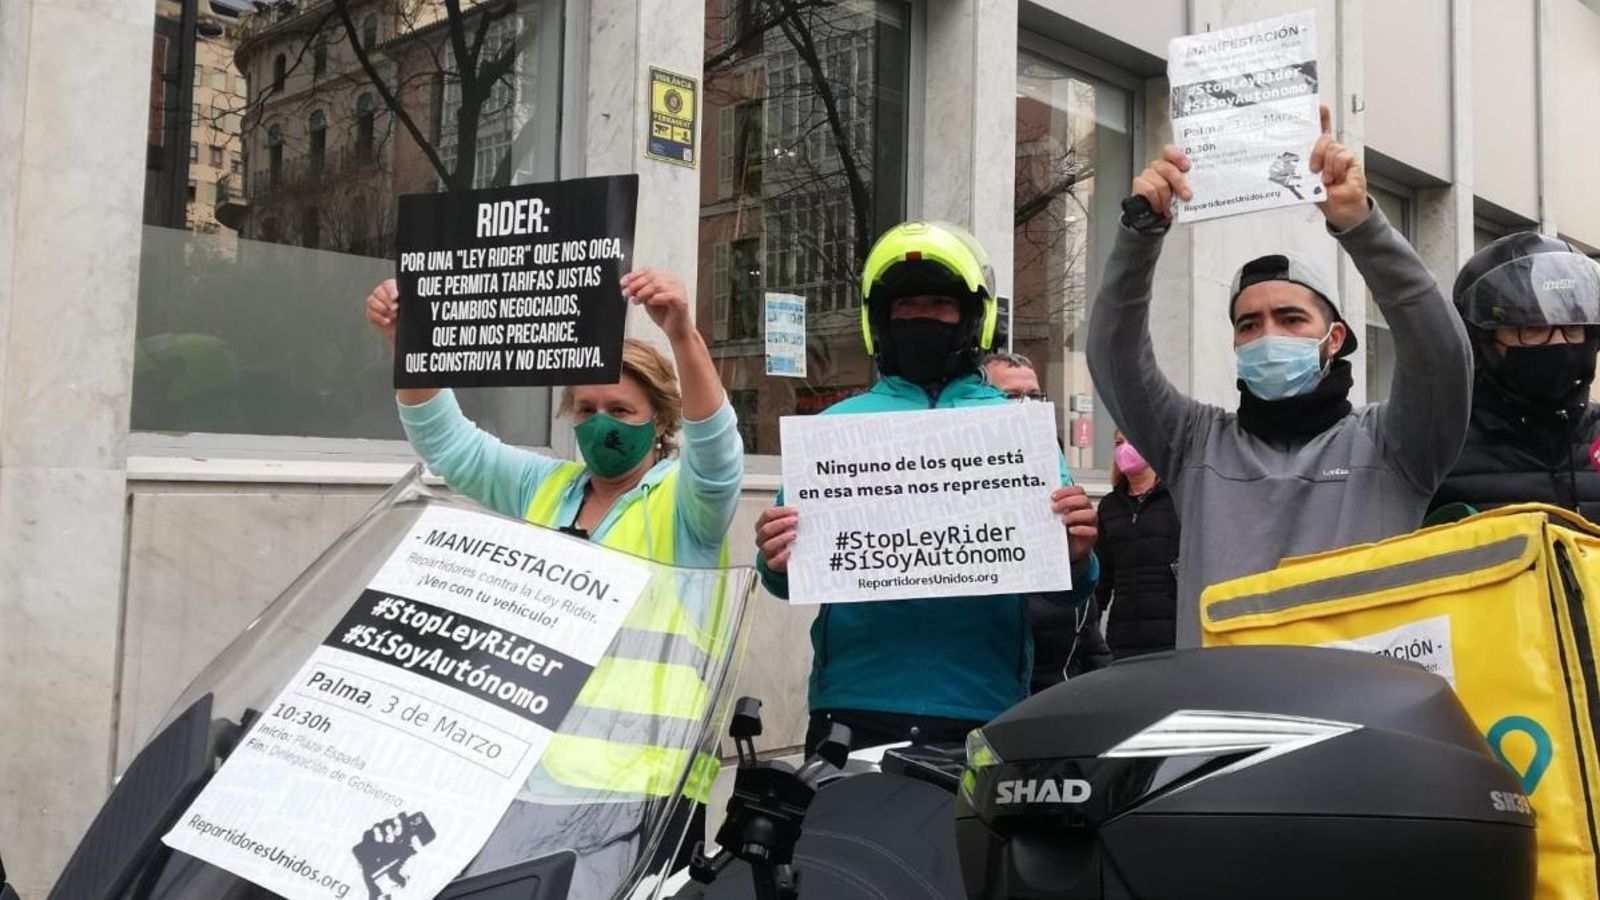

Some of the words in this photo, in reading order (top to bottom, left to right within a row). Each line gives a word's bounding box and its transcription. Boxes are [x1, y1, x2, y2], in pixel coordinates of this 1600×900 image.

[1188, 68, 1303, 96] #StopLeyRider
[476, 198, 550, 238] RIDER:
[401, 252, 425, 272] POR
[428, 250, 453, 271] UNA
[457, 248, 487, 269] "LEY
[489, 244, 531, 267] RIDER"
[534, 243, 559, 264] QUE
[562, 241, 587, 262] NOS
[589, 237, 625, 261] OIGA,
[417, 276, 441, 296] QUE
[444, 273, 499, 295] PERMITA
[501, 269, 554, 292] TARIFAS
[556, 265, 601, 289] JUSTAS
[431, 302, 440, 321] Y
[442, 299, 497, 320] CAMBIOS
[499, 294, 581, 318] NEGOCIADOS,
[432, 327, 457, 347] QUE
[459, 326, 477, 345] NO
[479, 324, 504, 344] NOS
[506, 321, 578, 343] PRECARICE,
[405, 352, 427, 373] QUE
[430, 350, 501, 372] CONSTRUYA
[504, 350, 514, 371] Y
[516, 349, 535, 370] NO
[537, 346, 604, 369] DESTRUYA.
[816, 460, 891, 477] Ninguno
[895, 456, 917, 471] de
[920, 455, 947, 470] los
[950, 456, 983, 472] que
[987, 449, 1025, 465] está
[799, 488, 820, 499] en
[823, 487, 853, 498] esa
[857, 484, 902, 496] mesa
[908, 482, 939, 494] nos
[943, 474, 1047, 494] representa.
[835, 523, 1017, 552] #StopLeyRider
[424, 529, 610, 600] MANIFESTACIÓN
[829, 544, 1026, 573] #SíSoyAutónomo
[406, 552, 477, 578] Repartidores
[478, 572, 519, 593] contra
[519, 581, 533, 597] la
[534, 587, 558, 608] Ley
[858, 572, 999, 591] RepartidoresUnidos.org
[416, 573, 448, 590] ¡Ven
[449, 581, 475, 598] con
[475, 590, 490, 604] tu
[494, 597, 561, 629] vehículo!
[370, 597, 564, 678] #StopLeyRider
[341, 624, 549, 715] #SíSoyAutónomo
[271, 703, 332, 733] 10:30h
[306, 671, 373, 709] Palma,
[380, 695, 399, 714] 3
[400, 703, 429, 727] de
[433, 716, 502, 760] Marzo
[258, 723, 294, 743] Inicio:
[294, 734, 323, 754] Plaza
[324, 746, 367, 771] España
[246, 737, 270, 753] Fin:
[270, 746, 329, 775] Delegación
[330, 768, 347, 782] de
[347, 775, 404, 808] Gobierno
[995, 779, 1092, 804] SHAD
[188, 814, 351, 899] RepartidoresUnidos.org
